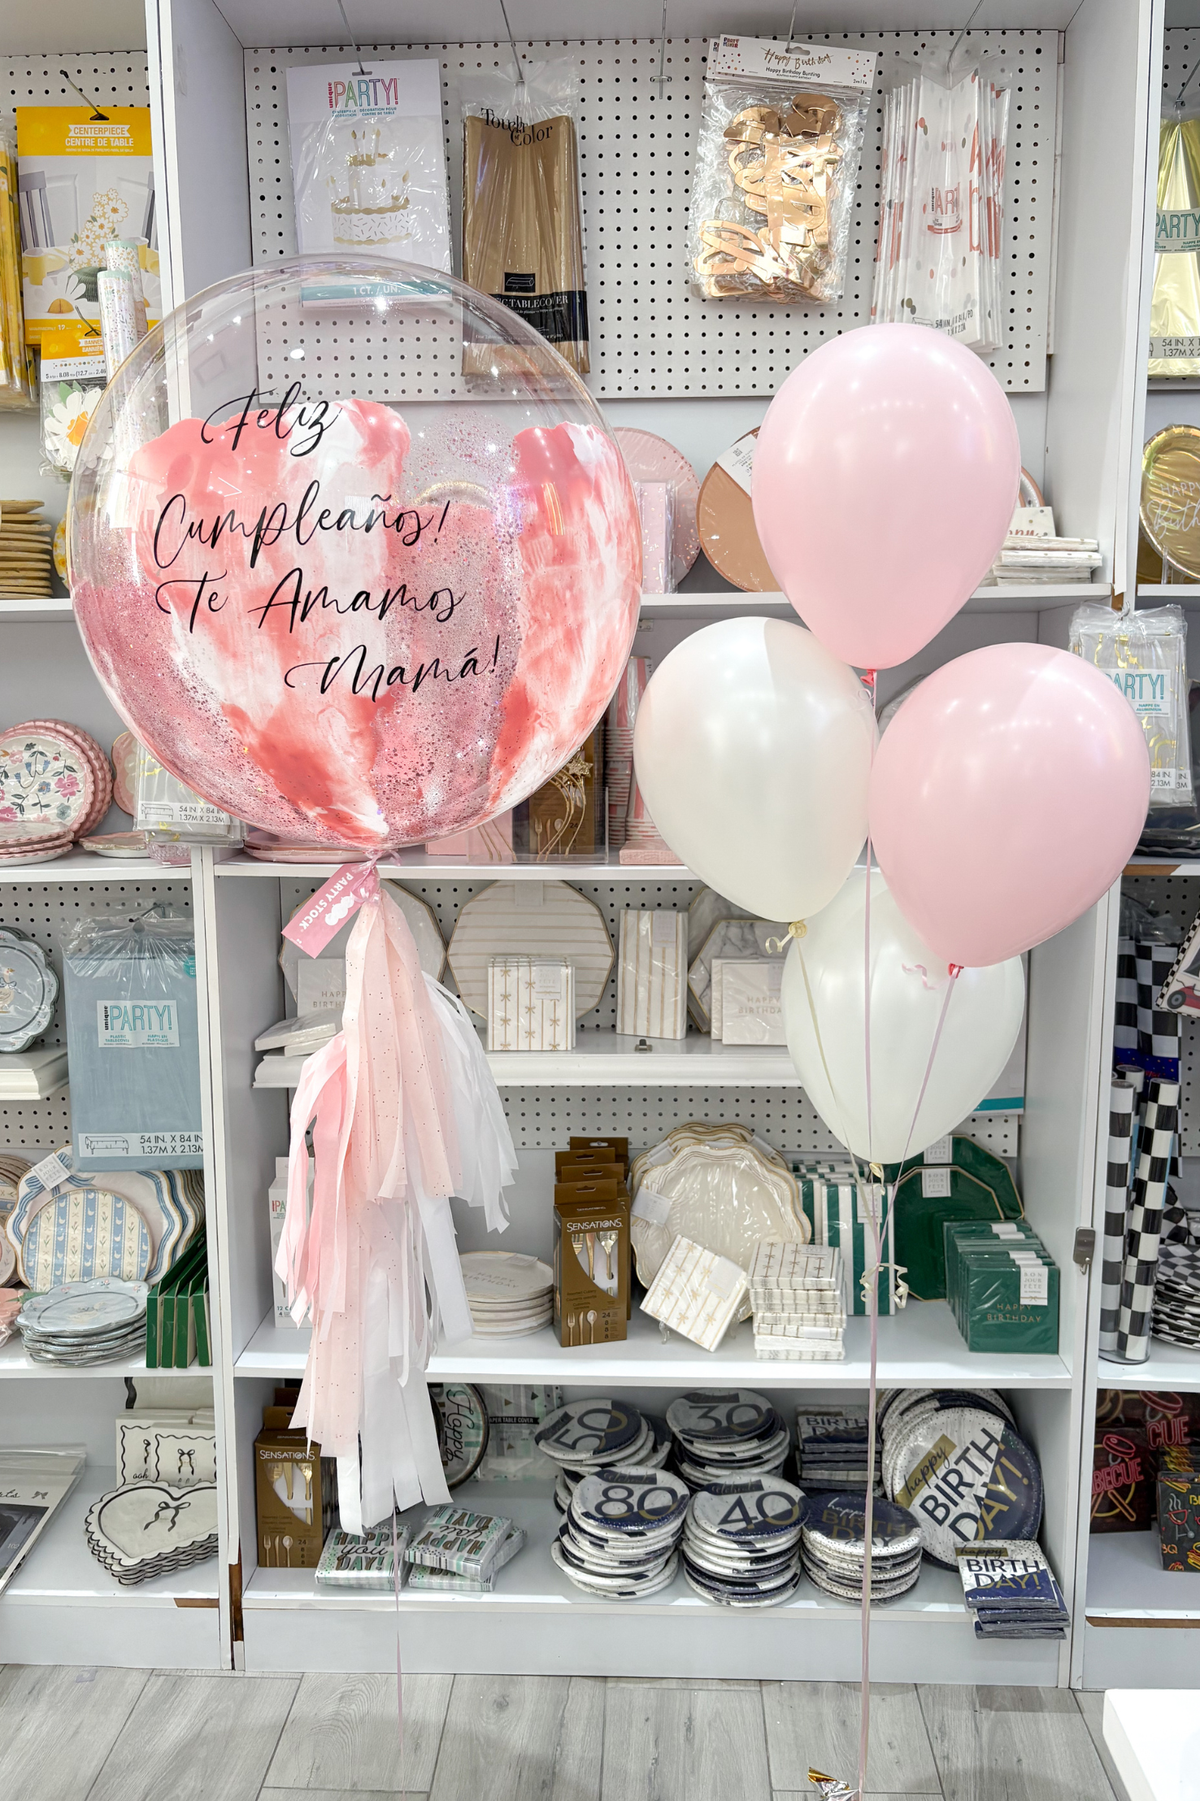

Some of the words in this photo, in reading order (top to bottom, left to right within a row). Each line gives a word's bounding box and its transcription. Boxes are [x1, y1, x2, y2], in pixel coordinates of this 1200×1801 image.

[802, 70, 821, 78] Bunting
[333, 77, 399, 108] PARTY!
[480, 107, 527, 134] Touch
[73, 126, 126, 136] CENTERPIECE
[510, 124, 553, 146] Color
[65, 138, 96, 147] CENTRE
[97, 138, 108, 147] DE
[109, 138, 134, 147] TABLE
[359, 287, 374, 295] CT.
[383, 285, 401, 294] UN.
[1161, 338, 1172, 347] 54
[1174, 338, 1186, 347] IN.
[1163, 348, 1187, 357] 1.37M
[200, 381, 342, 457] Feliz
[1146, 497, 1200, 540] Birth
[155, 568, 230, 634] Te
[247, 567, 467, 634] Amamos
[284, 634, 501, 703] Mamá!
[1105, 672, 1165, 700] ARTY!
[1151, 779, 1171, 787] 2.13M
[178, 805, 188, 813] 54
[179, 813, 198, 822] 1.37M
[205, 815, 225, 823] 2.13M
[325, 872, 354, 902] PARTY
[299, 899, 328, 930] STOCK
[321, 990, 347, 998] HAPP
[747, 996, 781, 1004] HAPPY
[312, 1000, 345, 1009] BIRTH
[738, 1006, 782, 1014] BIRTHDA
[109, 1004, 173, 1032] PARTY!
[140, 1135, 152, 1144] 54
[154, 1134, 168, 1144] IN.
[170, 1134, 177, 1144] X
[179, 1134, 192, 1143] 84
[141, 1145, 169, 1155] 1.37M
[170, 1145, 177, 1154] X
[566, 1217, 622, 1233] SENSATIONS
[462, 1273, 520, 1289] BIRTHDAY
[477, 1272, 515, 1283] HAPPY
[601, 1311, 611, 1319] 24
[996, 1303, 1033, 1311] HAPPY
[986, 1313, 1042, 1323] BIRTHDAY
[445, 1388, 476, 1462] Happy
[688, 1403, 764, 1433] 30
[805, 1416, 868, 1427] BIRTH
[551, 1407, 628, 1451] 50
[904, 1444, 951, 1498] happy
[919, 1427, 1006, 1527] BIRTH
[594, 1484, 679, 1520] 80
[948, 1456, 1029, 1542] DAY!
[717, 1491, 800, 1529] 40
[449, 1509, 493, 1528] DAY!
[821, 1509, 907, 1536] BIRTH
[334, 1531, 403, 1546] HAPPY
[416, 1530, 487, 1556] HAPPY
[336, 1543, 390, 1561] you
[335, 1556, 385, 1571] DAY!
[966, 1558, 1041, 1573] BIRTH
[974, 1573, 1042, 1590] DAY!
